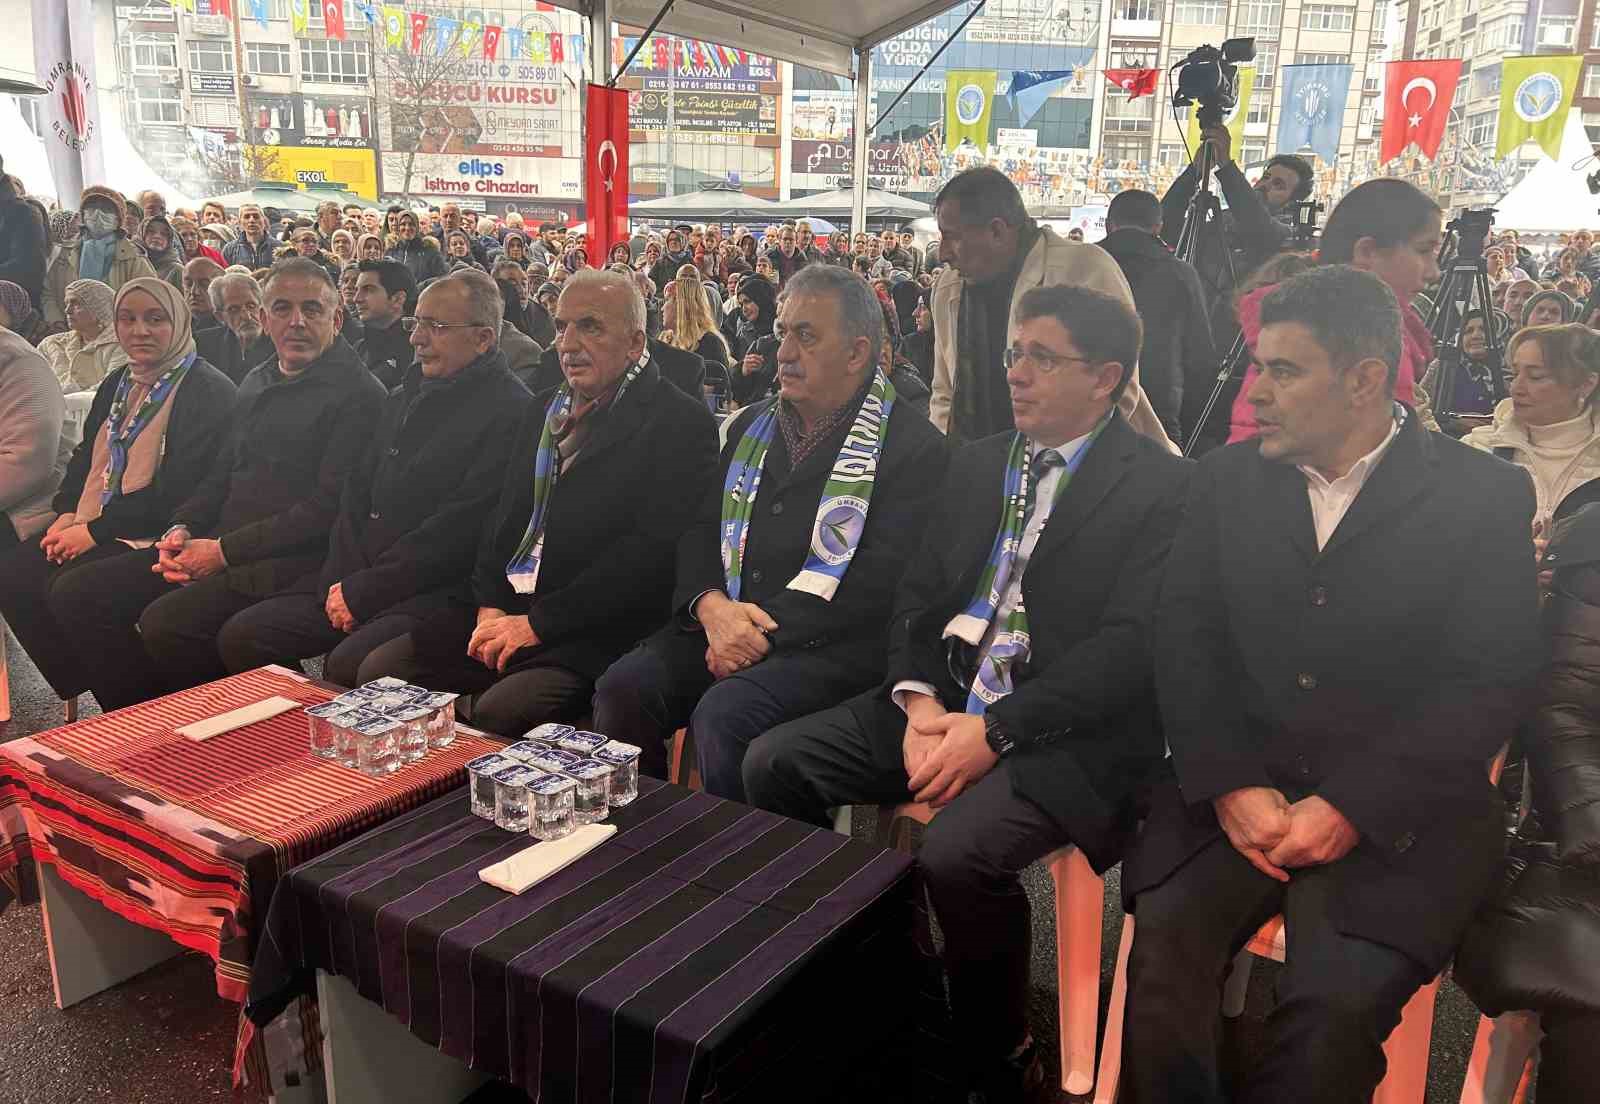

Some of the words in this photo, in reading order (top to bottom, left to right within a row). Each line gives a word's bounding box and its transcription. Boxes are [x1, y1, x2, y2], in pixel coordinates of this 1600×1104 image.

[881, 41, 933, 54] YOLDA
[883, 52, 928, 66] YÜRÜ
[677, 64, 731, 79] KAVRAM
[487, 85, 558, 105] KURSU
[533, 118, 559, 130] SANAT
[458, 158, 505, 178] elips
[296, 171, 327, 183] EKOL
[424, 175, 470, 193] İşitme
[475, 179, 539, 195] Cihazları
